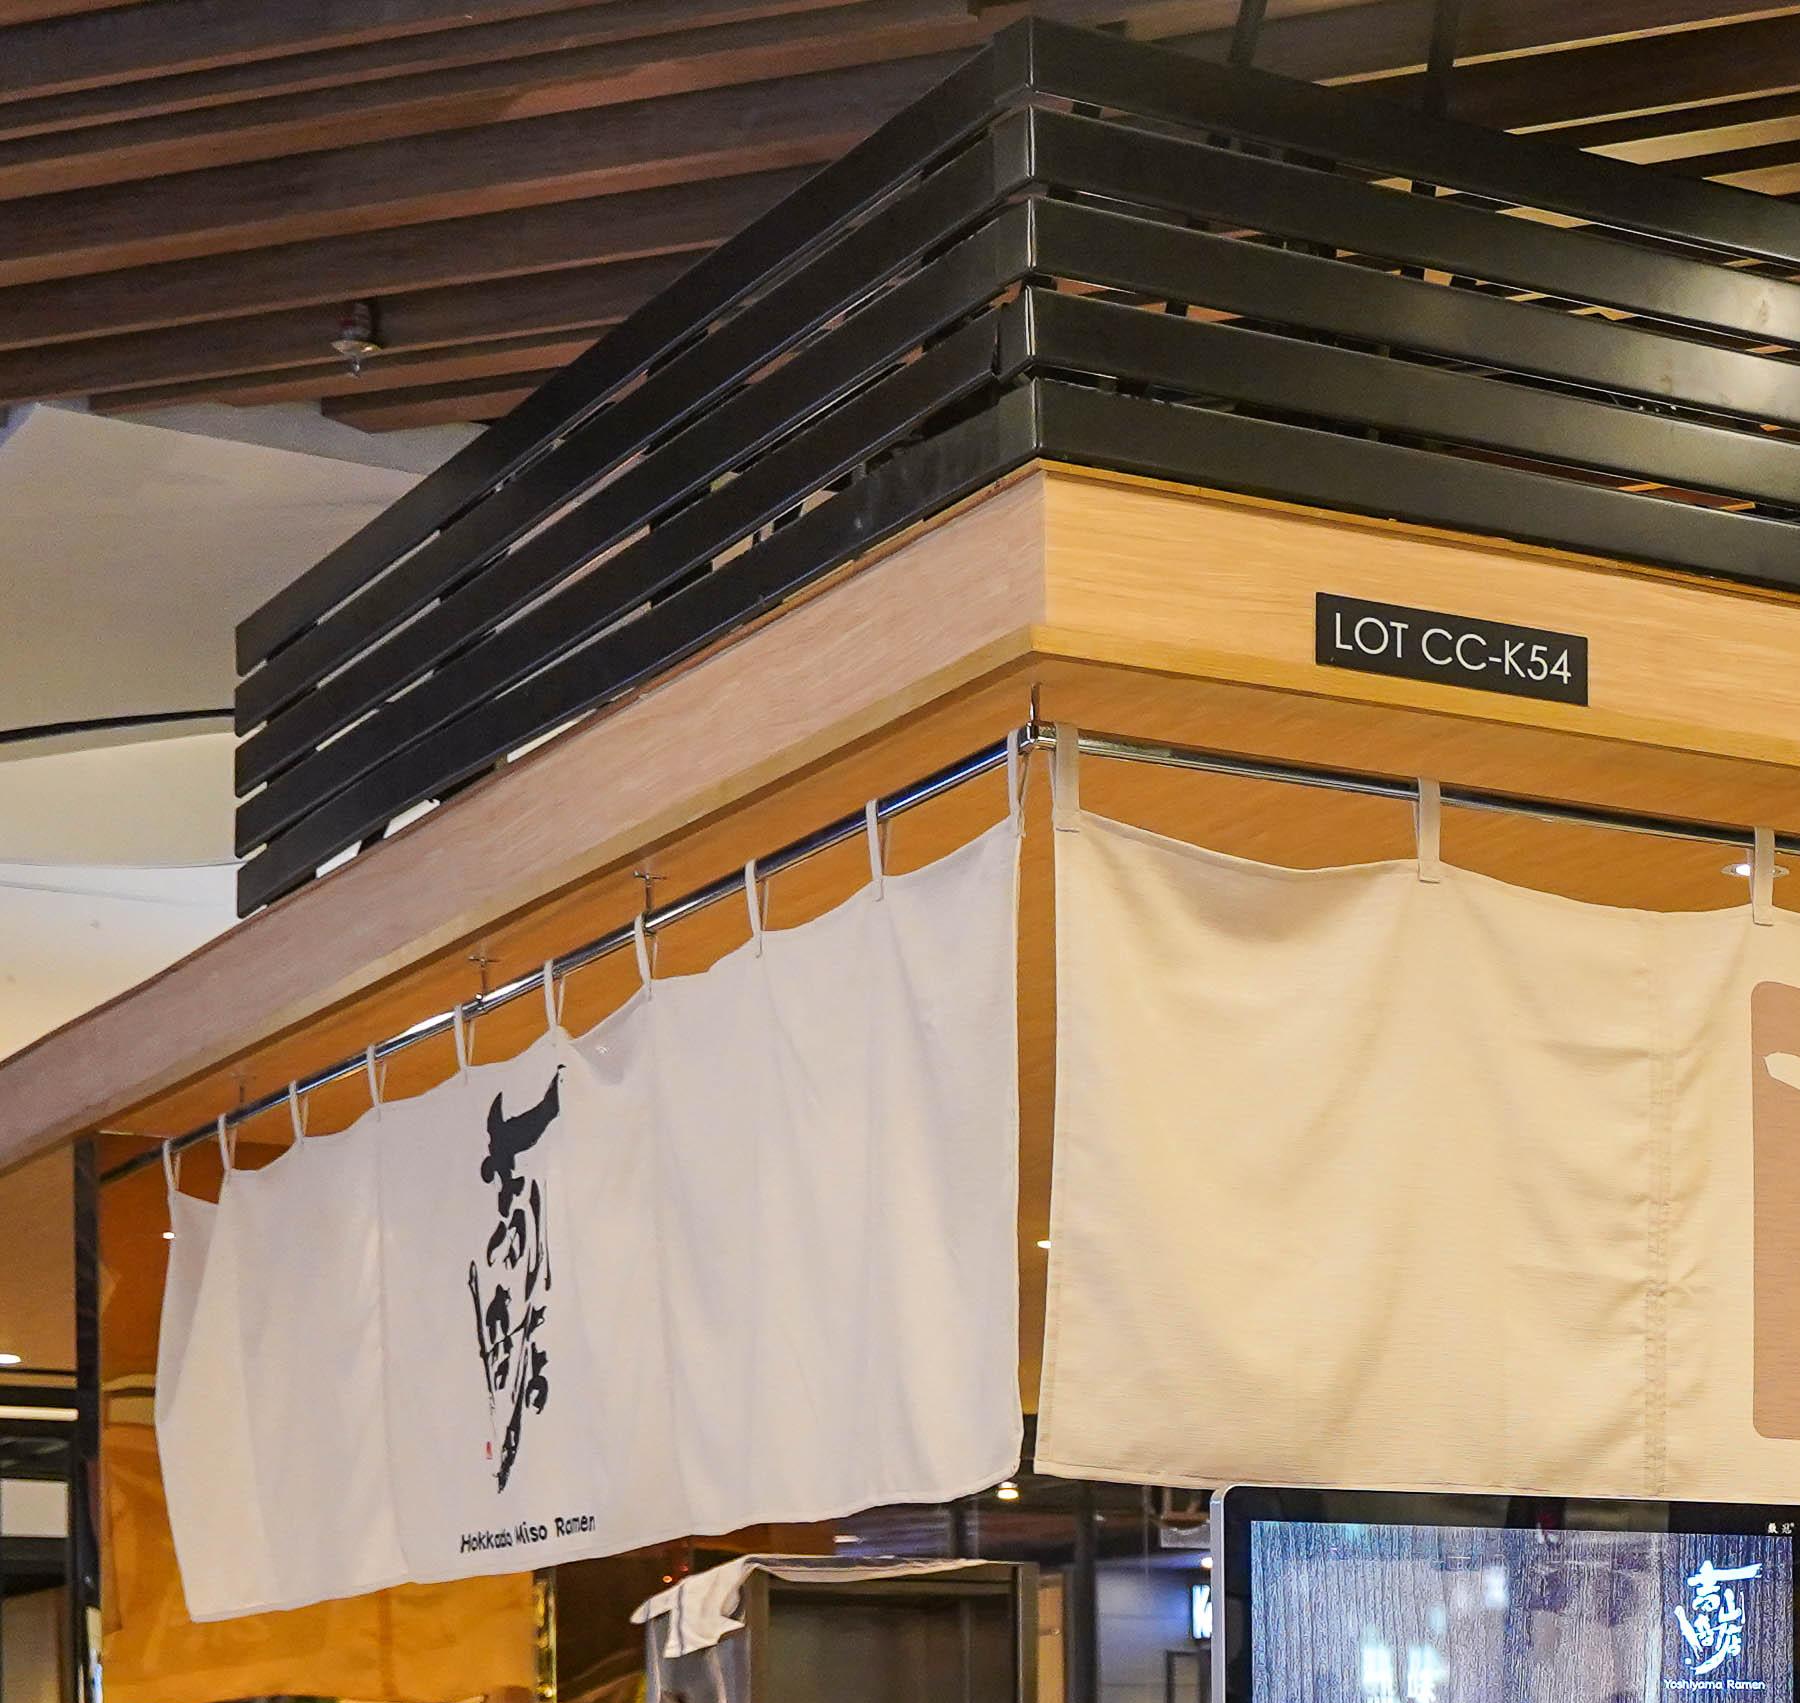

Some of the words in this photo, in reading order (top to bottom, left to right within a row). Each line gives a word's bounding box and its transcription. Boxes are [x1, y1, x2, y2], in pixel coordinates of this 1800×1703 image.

[1335, 612, 1408, 658] LOT
[1421, 627, 1572, 684] CC-K54
[515, 1521, 548, 1544] Miso
[554, 1514, 595, 1537] Ramen
[1664, 1679, 1723, 1692] Yoshiyama
[1726, 1680, 1766, 1690] Ramen
